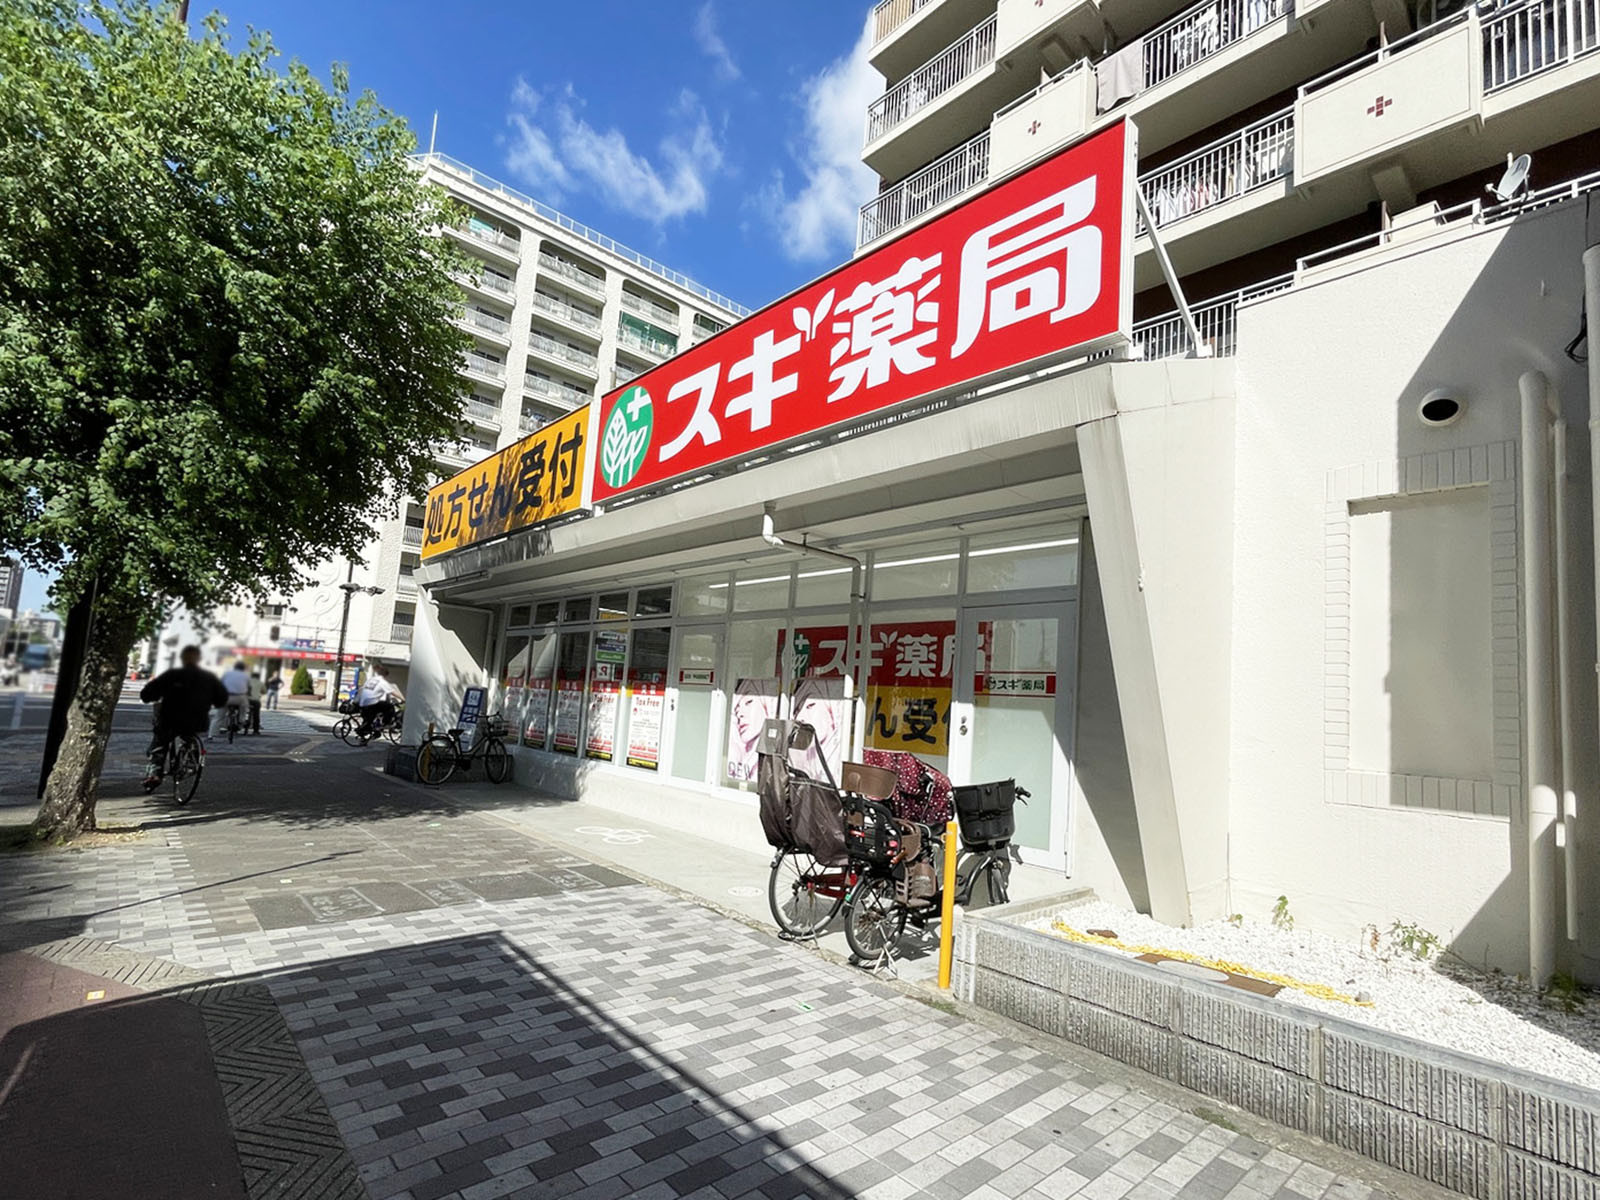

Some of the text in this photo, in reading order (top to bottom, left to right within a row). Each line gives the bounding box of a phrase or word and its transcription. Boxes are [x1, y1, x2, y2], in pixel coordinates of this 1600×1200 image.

[658, 173, 1103, 463] スギ薬局
[424, 422, 584, 548] 処方せん受付
[635, 696, 660, 707] Tax Free
[996, 677, 1045, 690] スギ薬局
